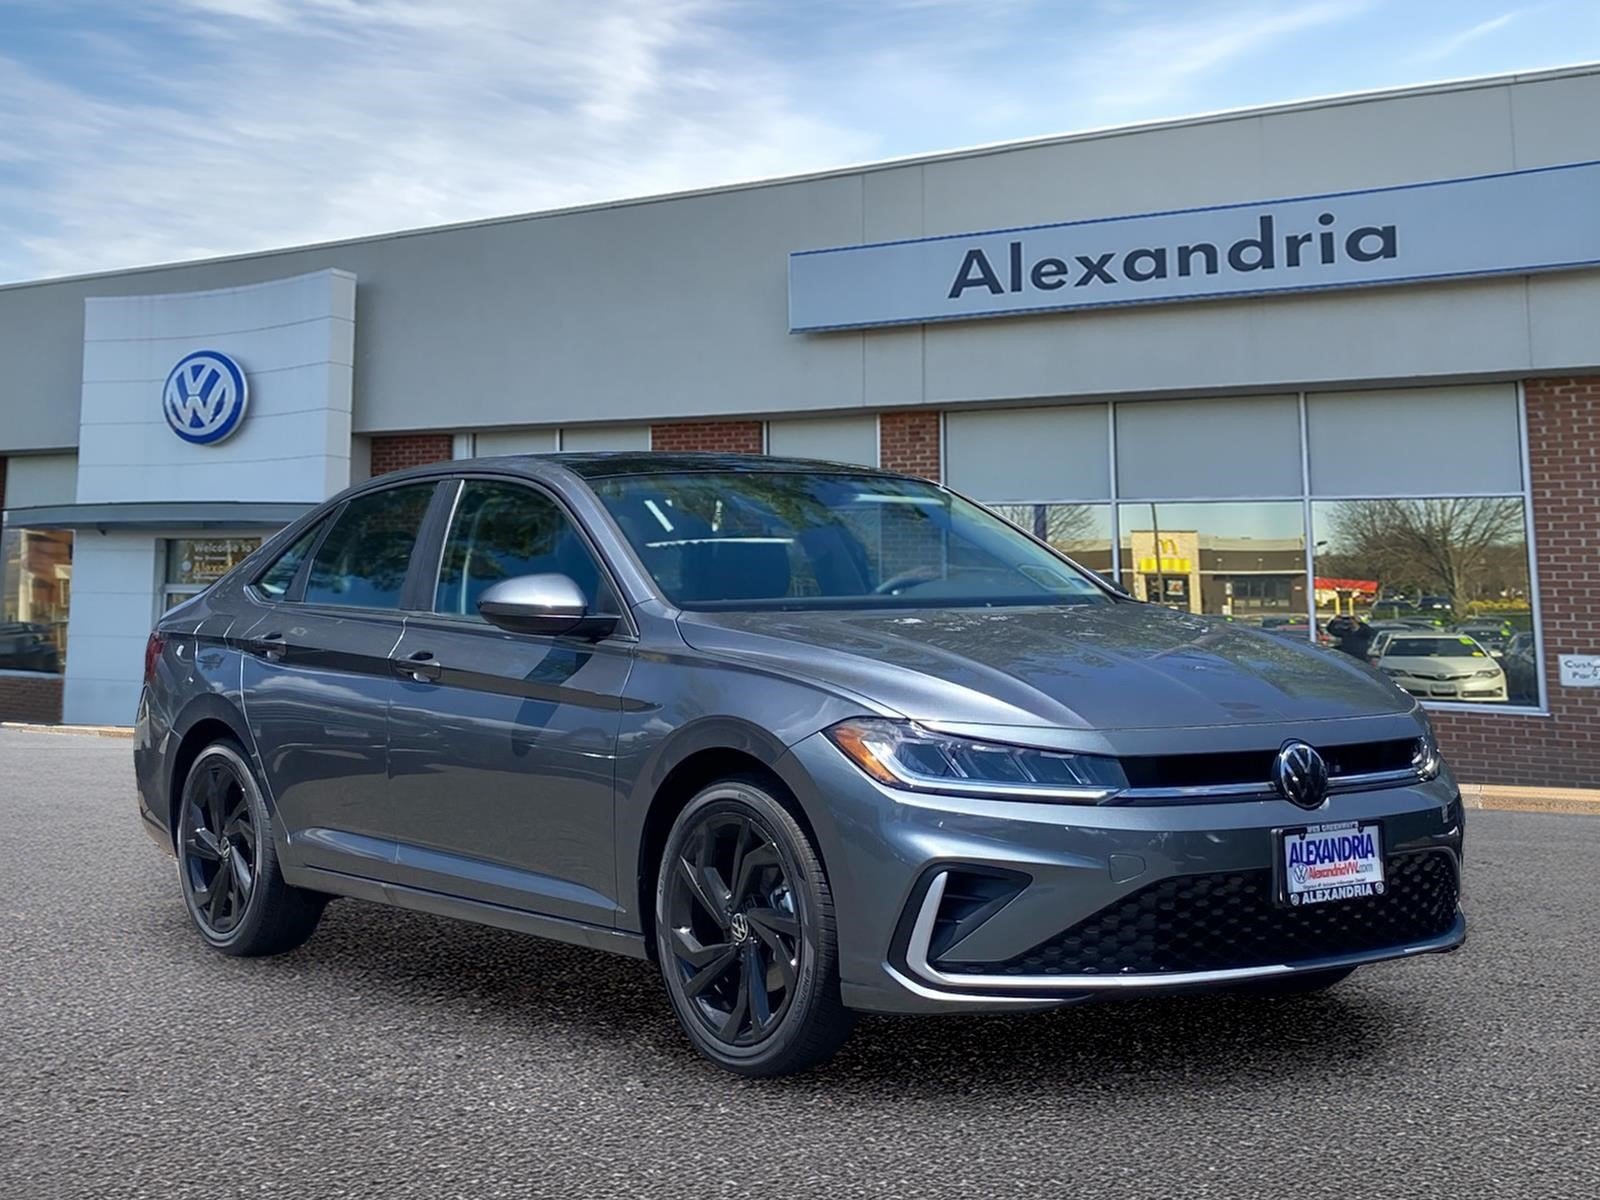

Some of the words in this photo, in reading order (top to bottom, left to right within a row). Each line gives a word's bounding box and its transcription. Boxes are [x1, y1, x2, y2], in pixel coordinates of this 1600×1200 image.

[948, 213, 1398, 299] Alexandria
[163, 351, 245, 443] VW
[1289, 833, 1375, 868] ALEXANDRIA
[1302, 883, 1374, 905] ALEXANDRIA
